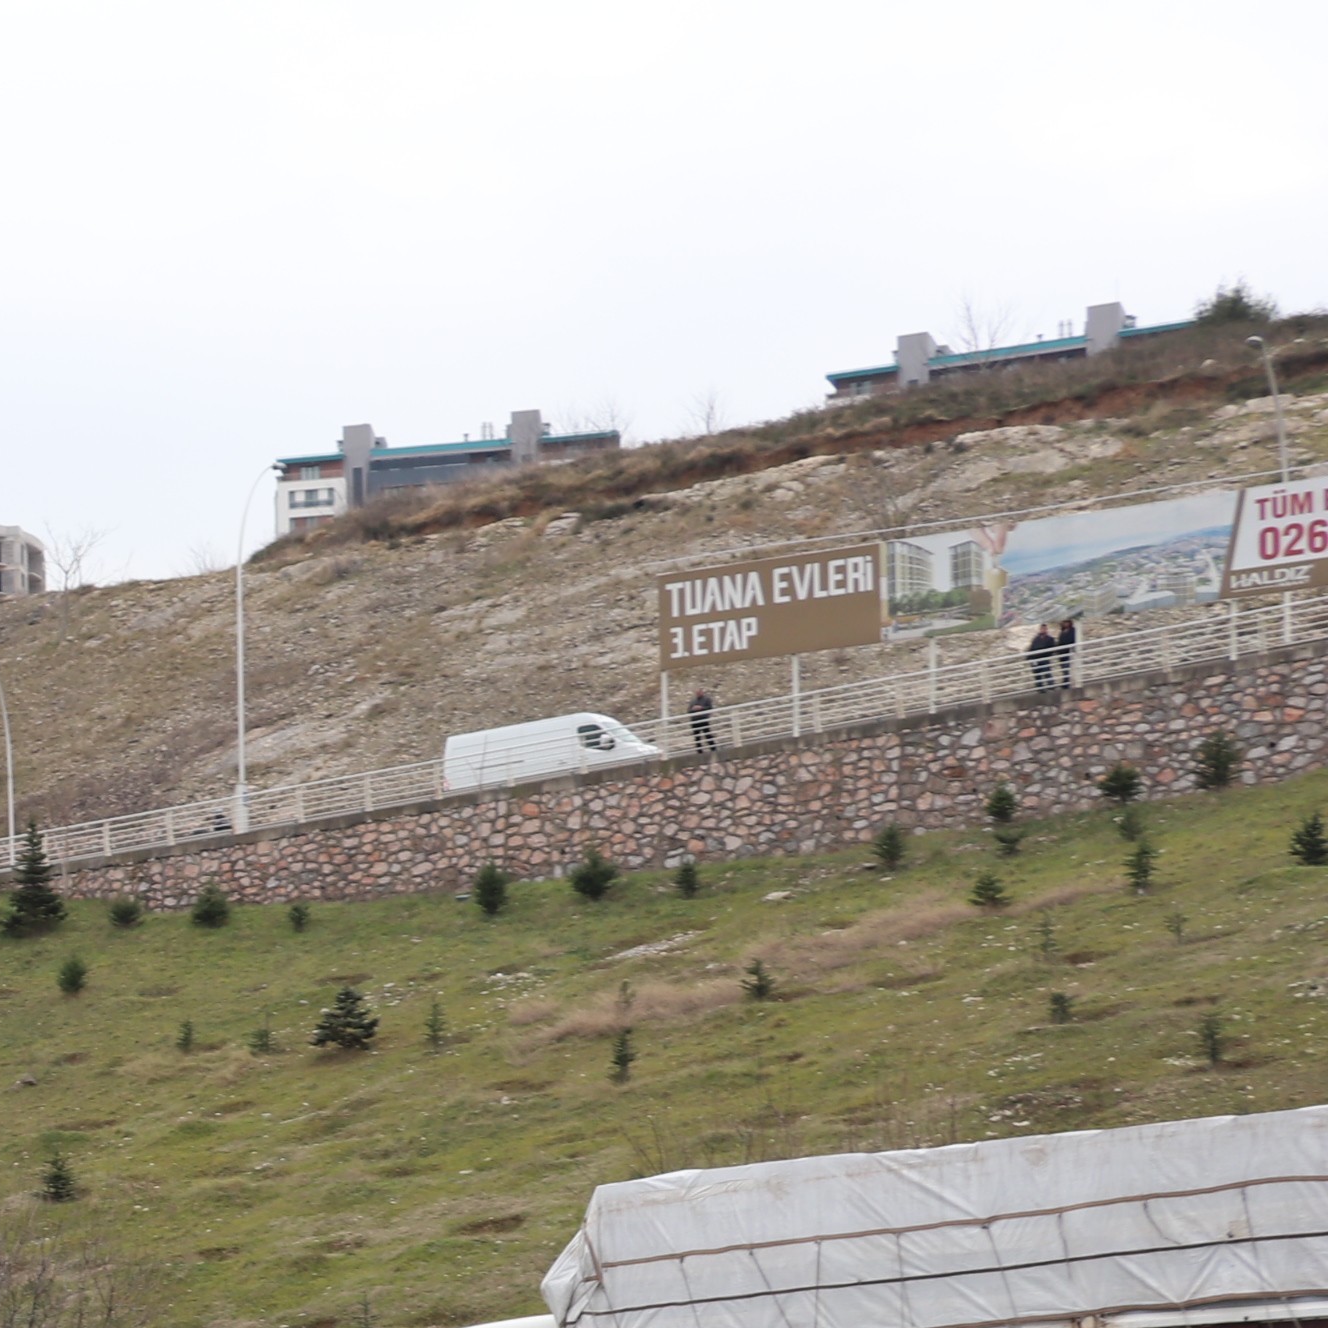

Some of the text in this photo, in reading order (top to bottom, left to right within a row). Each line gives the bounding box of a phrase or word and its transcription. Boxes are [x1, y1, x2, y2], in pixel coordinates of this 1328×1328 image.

[1255, 489, 1313, 520] TÜM
[665, 555, 874, 617] TUANA EVLERİ
